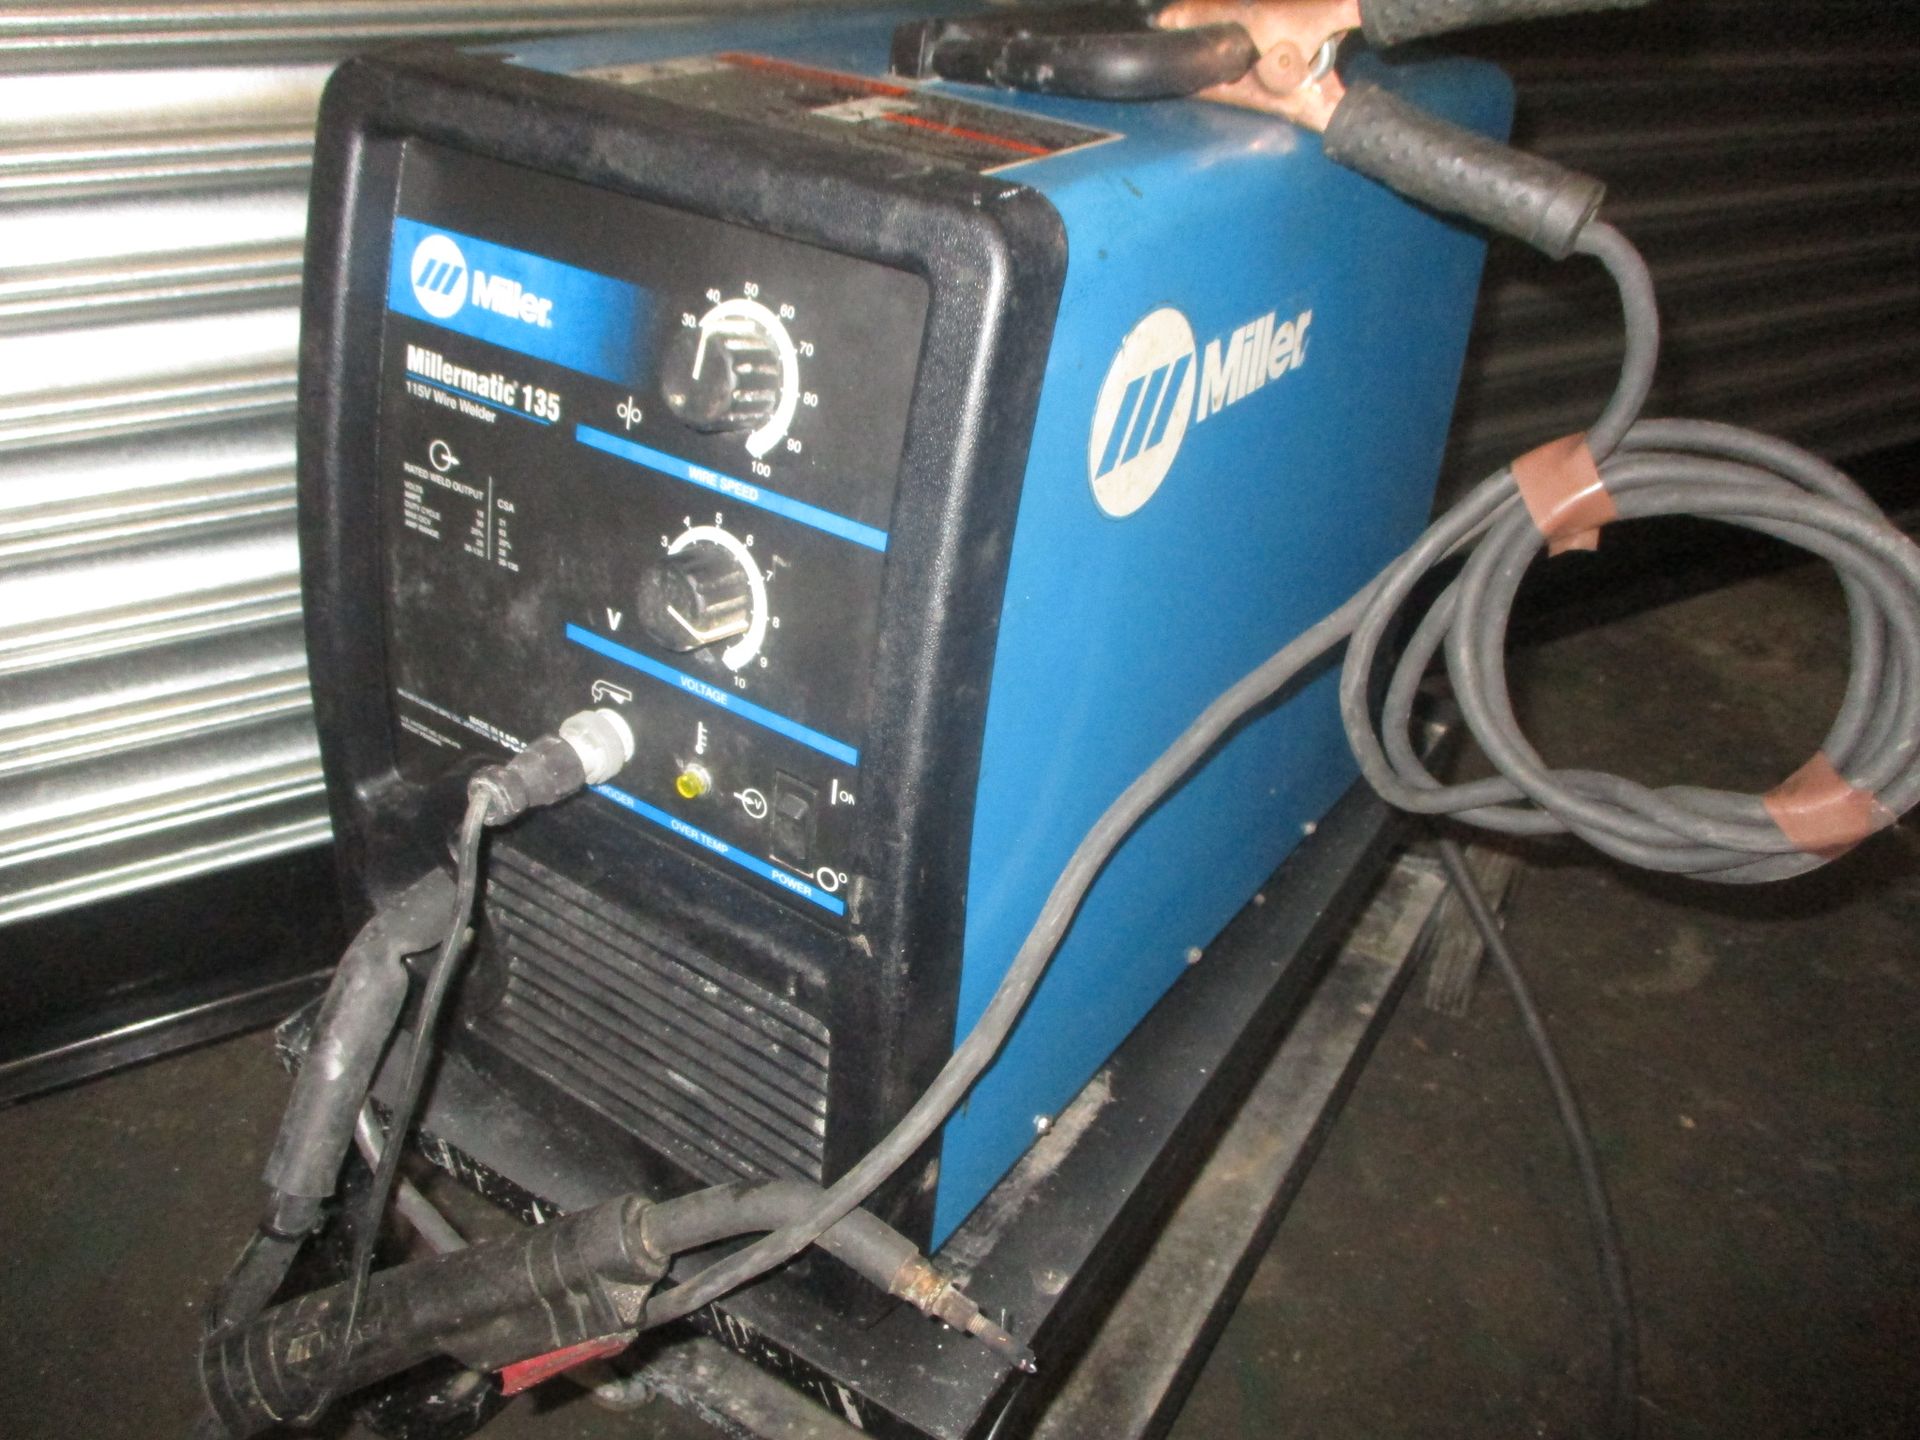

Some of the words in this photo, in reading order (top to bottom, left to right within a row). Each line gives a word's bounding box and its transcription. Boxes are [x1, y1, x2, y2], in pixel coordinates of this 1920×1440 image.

[705, 288, 721, 303] 40
[743, 282, 759, 297] 50
[471, 269, 553, 328] Miller
[779, 304, 795, 319] 60
[681, 312, 695, 328] 30
[799, 341, 814, 357] 70
[1196, 309, 1312, 423] Miller
[405, 380, 427, 400] 115V
[428, 388, 457, 409] Wire
[459, 398, 497, 423] Welder
[522, 384, 561, 423] 135
[803, 391, 818, 407] 80
[786, 438, 802, 453] 90
[751, 461, 771, 477] 100
[403, 461, 430, 480] RATED
[430, 472, 452, 489] WELD
[452, 481, 484, 501] OUTPUT
[688, 465, 718, 487] WIRE
[719, 476, 759, 500] SPEED
[497, 498, 515, 513] CSA
[683, 516, 690, 527] 4
[715, 512, 723, 524] 5
[660, 535, 668, 547] 3
[745, 534, 754, 546] 6
[765, 569, 774, 582] 7
[606, 607, 622, 631] V
[772, 616, 780, 629] 8
[760, 656, 768, 668] 9
[733, 675, 746, 689] 10
[680, 676, 728, 705] VOLTAGE
[671, 818, 699, 841] OVER
[699, 832, 729, 853] TEMP
[771, 869, 812, 897] POWER
